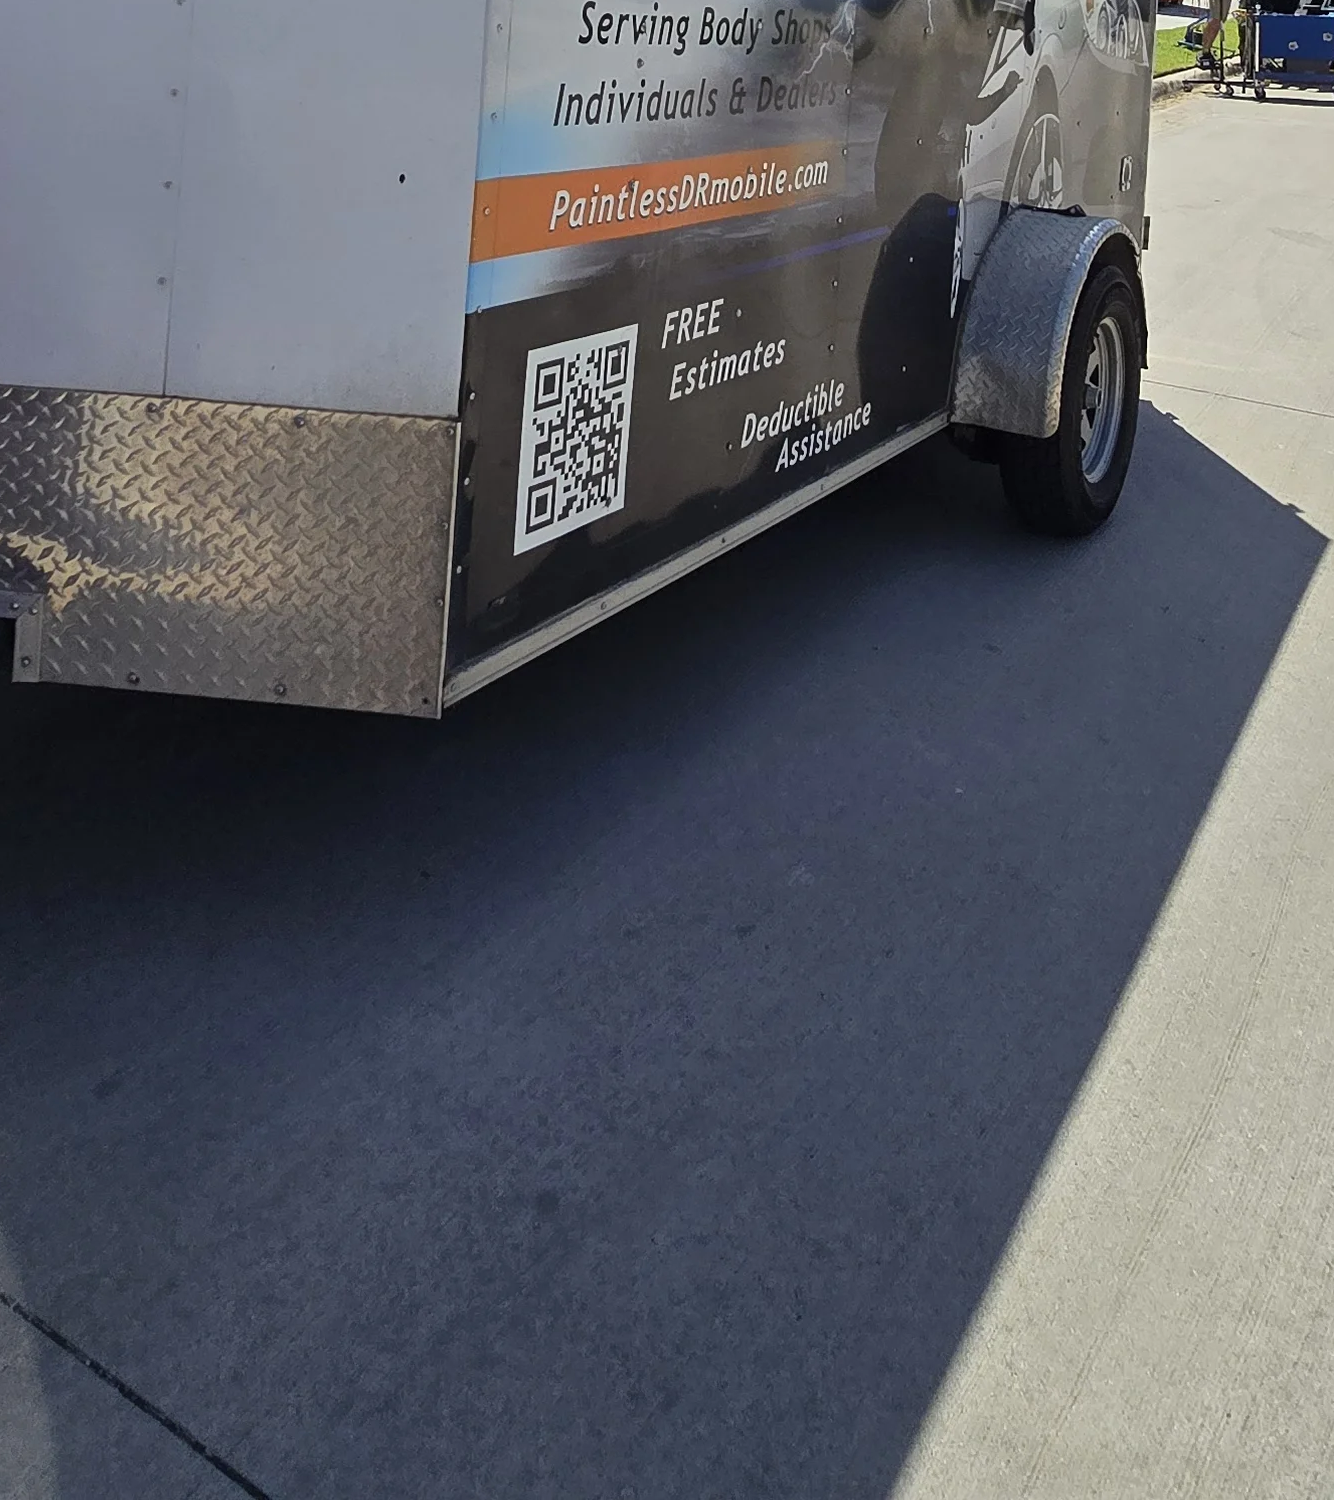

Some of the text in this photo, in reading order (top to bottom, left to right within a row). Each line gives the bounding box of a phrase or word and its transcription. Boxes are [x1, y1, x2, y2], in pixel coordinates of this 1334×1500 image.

[577, 0, 834, 56] Serving Body Shops
[552, 75, 837, 127] Individuals & Dealers
[548, 158, 830, 232] PaintlessDRmobile.com
[660, 298, 725, 350] FREE
[668, 338, 787, 402] Estimates
[740, 378, 845, 449] Deductible
[774, 401, 872, 473] Assistance
